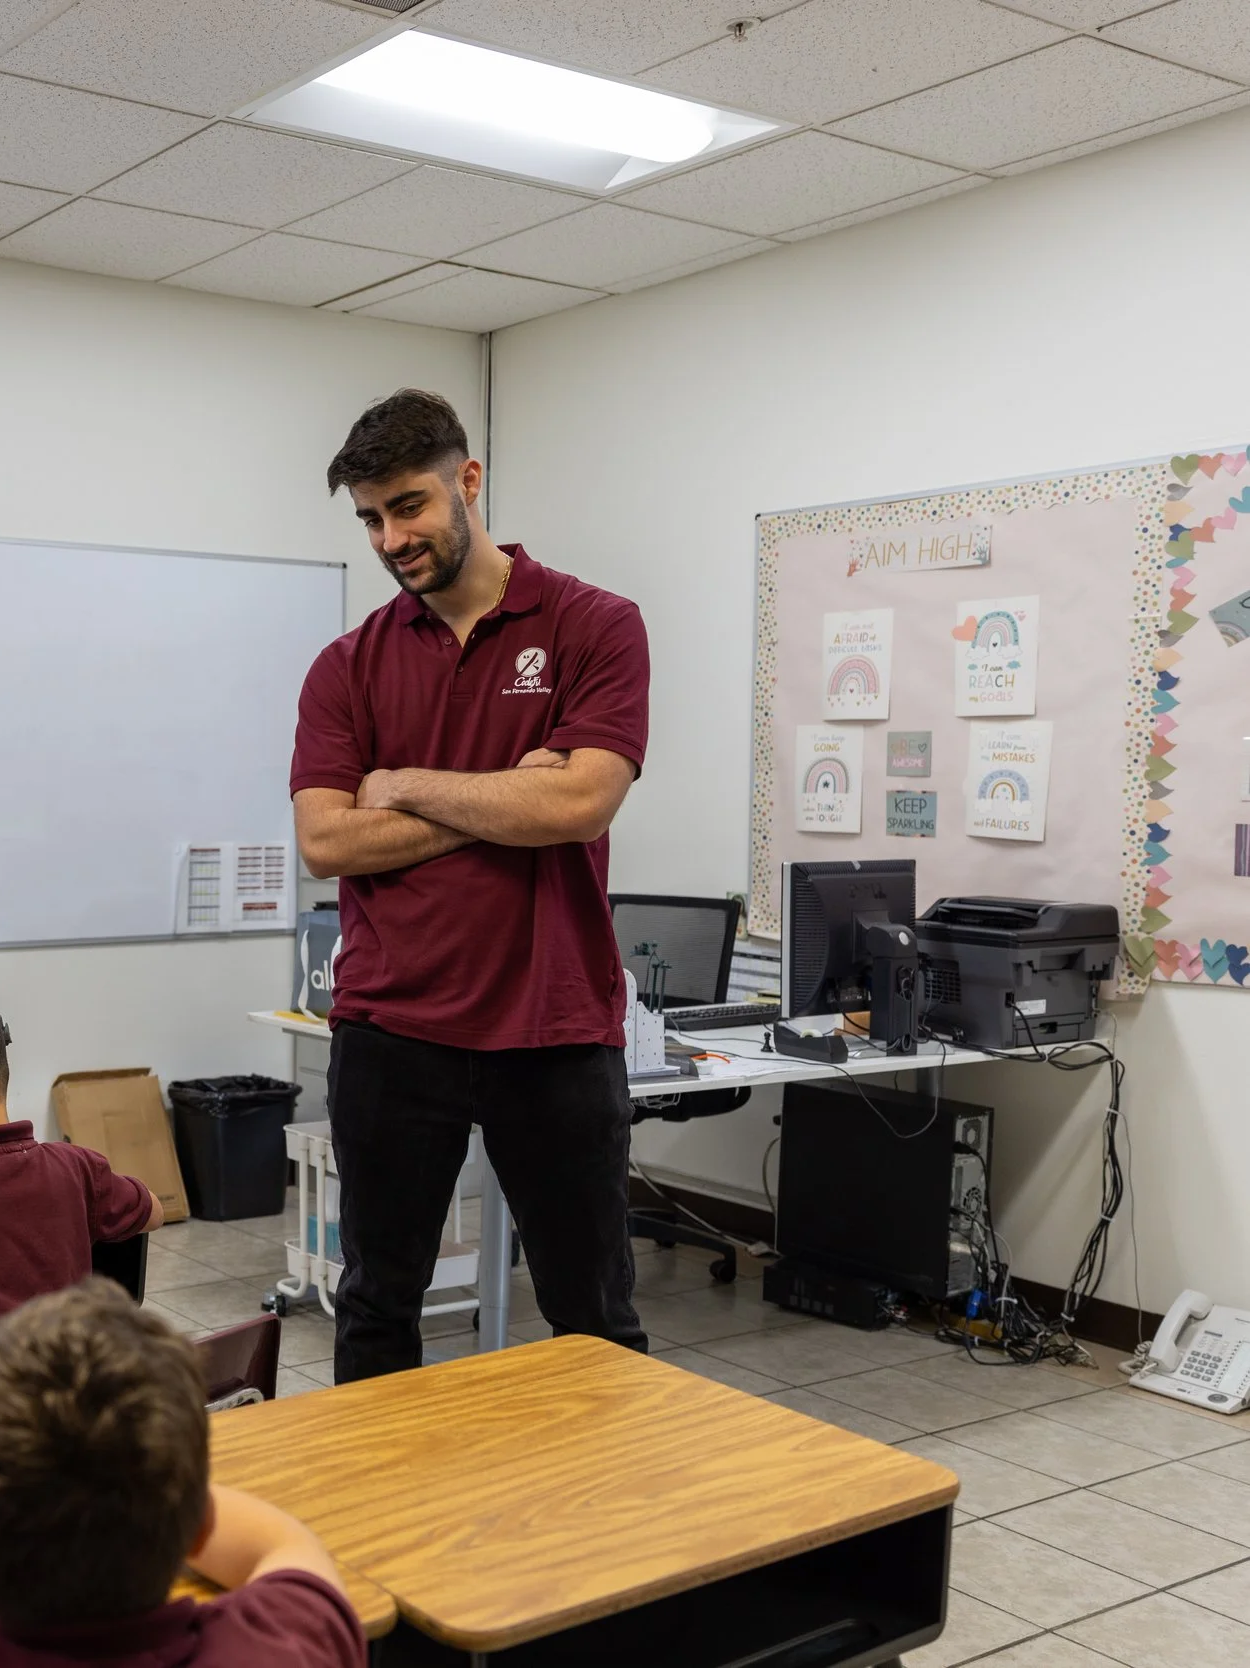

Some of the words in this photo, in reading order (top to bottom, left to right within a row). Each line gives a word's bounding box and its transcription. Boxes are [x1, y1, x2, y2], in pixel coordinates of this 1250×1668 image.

[865, 541, 906, 568] AIM
[919, 532, 972, 564] HIGH
[969, 674, 1015, 688] REACH
[814, 743, 840, 752] GOING
[988, 741, 1012, 749] LEARN
[992, 752, 1036, 763] MISTAKES
[894, 798, 927, 815] KEEP
[887, 817, 934, 830] SPARKLING
[985, 819, 1030, 832] FAILURES
